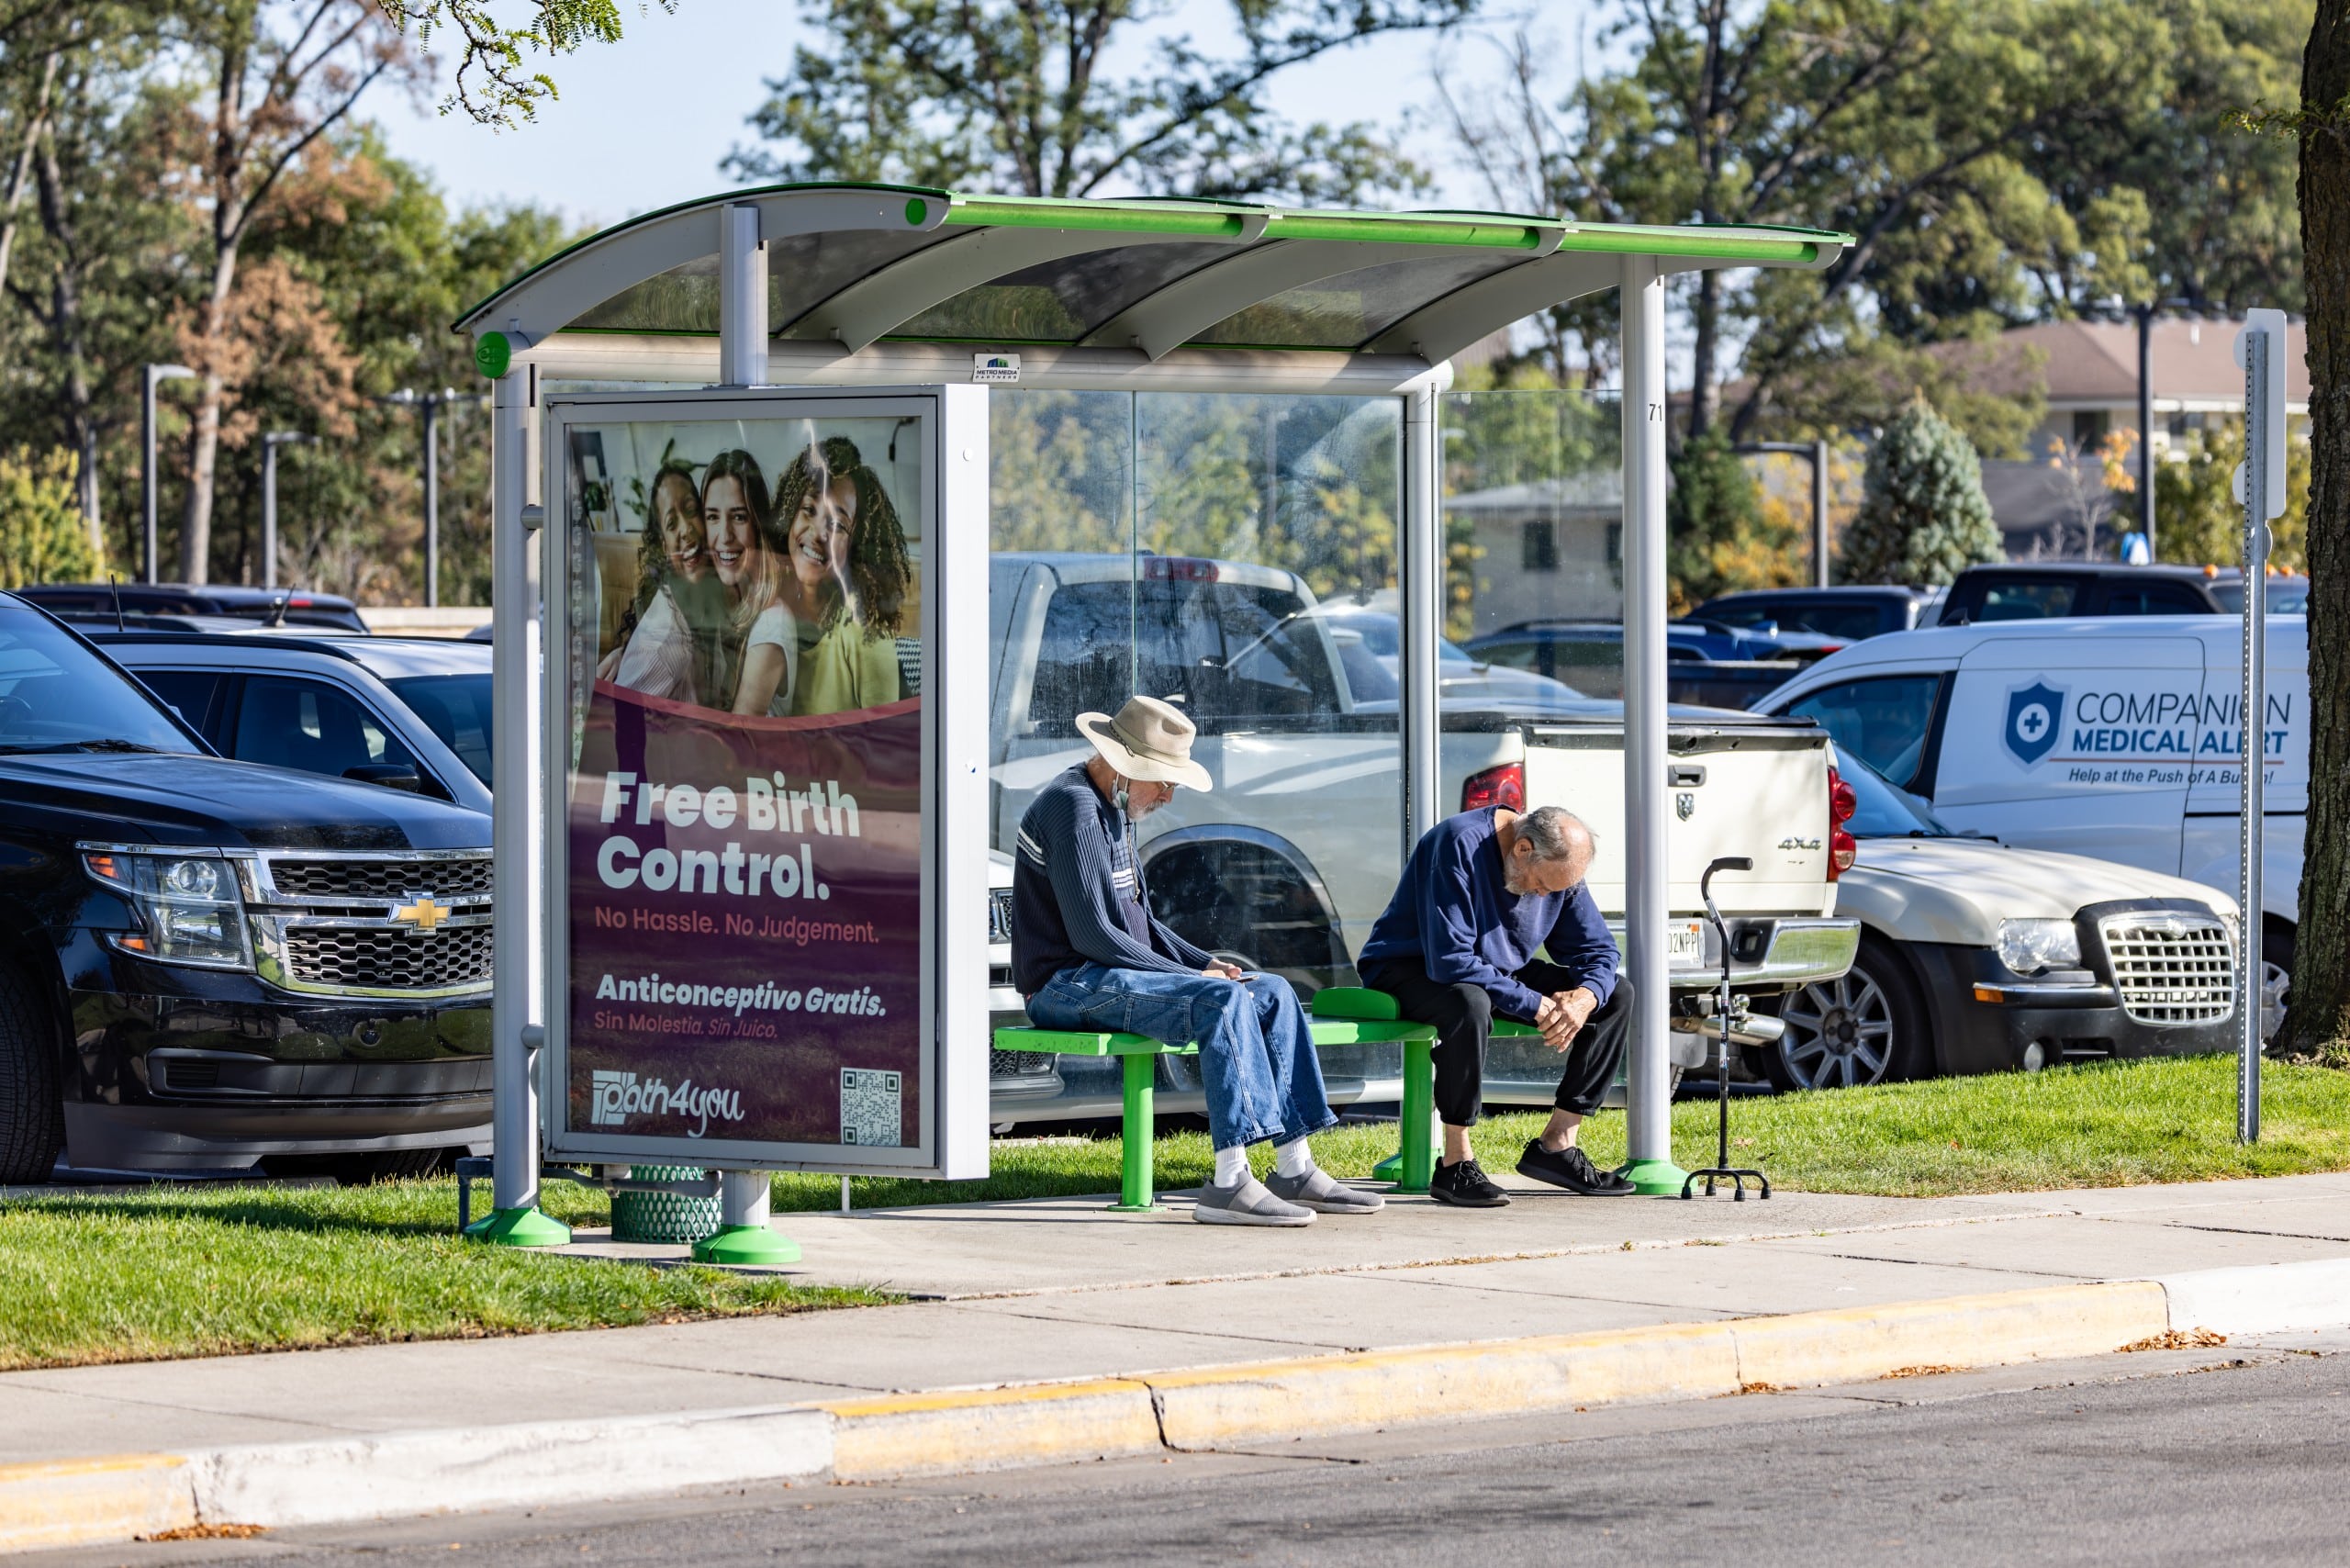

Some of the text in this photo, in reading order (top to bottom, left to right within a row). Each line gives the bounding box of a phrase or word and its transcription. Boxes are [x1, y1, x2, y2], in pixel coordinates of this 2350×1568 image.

[1649, 403, 1662, 422] 71
[2076, 693, 2291, 725] COMPANIN
[2072, 729, 2190, 753] MEDICAL
[2068, 767, 2100, 784] Help
[2104, 769, 2118, 782] at
[2121, 768, 2144, 782] the
[2147, 769, 2184, 783] Push
[2188, 770, 2203, 784] of
[2205, 770, 2216, 784] A
[600, 770, 860, 837] Free Birth
[597, 835, 830, 901] Control.
[595, 906, 879, 946] No Hassle. No Judgement.
[596, 973, 887, 1017] Anticonceptivo Gratis.
[594, 1010, 778, 1039] Sin Molestia. Sin Juico.
[591, 1070, 745, 1138] path4you
